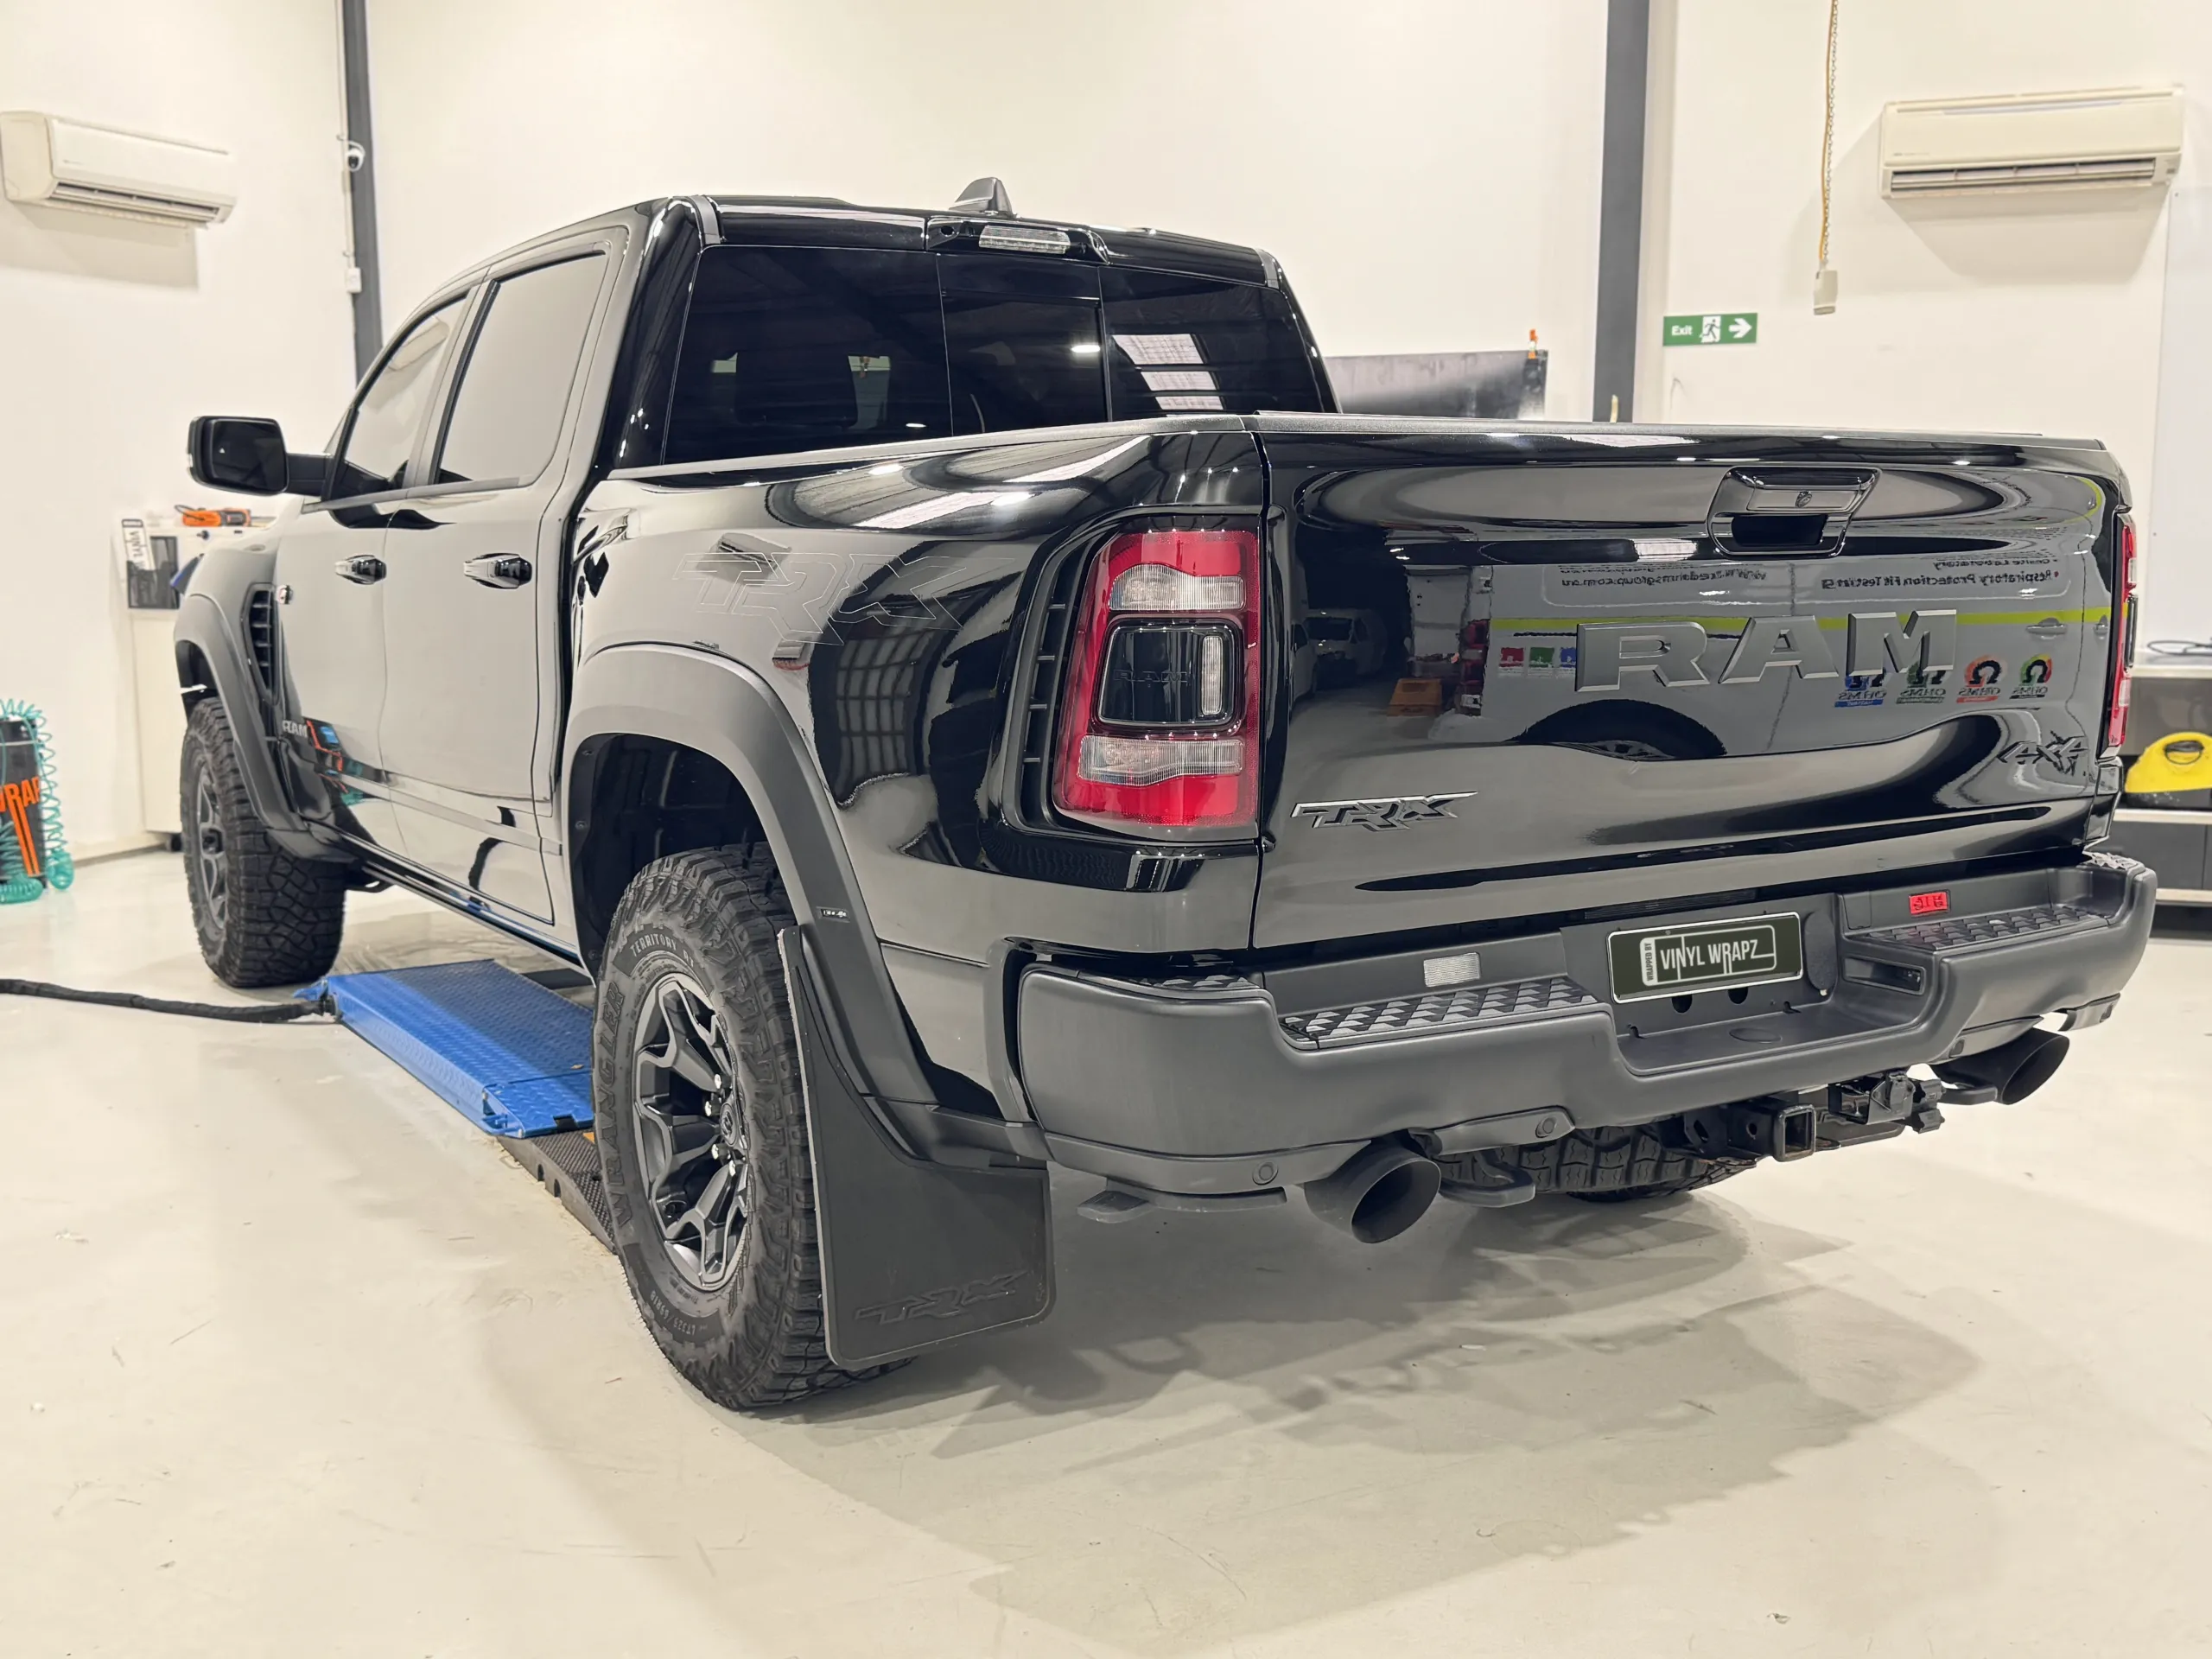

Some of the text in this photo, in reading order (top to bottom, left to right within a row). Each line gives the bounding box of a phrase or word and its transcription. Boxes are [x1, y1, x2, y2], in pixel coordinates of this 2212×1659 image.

[1671, 324, 1694, 337] Exit
[1576, 609, 1957, 692] RAM
[282, 719, 308, 739] RAM
[1290, 791, 1478, 833] TRX
[629, 932, 677, 957] TERRITORY
[1644, 943, 1654, 982] WRAPPED BY
[1660, 938, 1759, 971] VINYL WRAPZ
[596, 981, 634, 1229] WRANGLER
